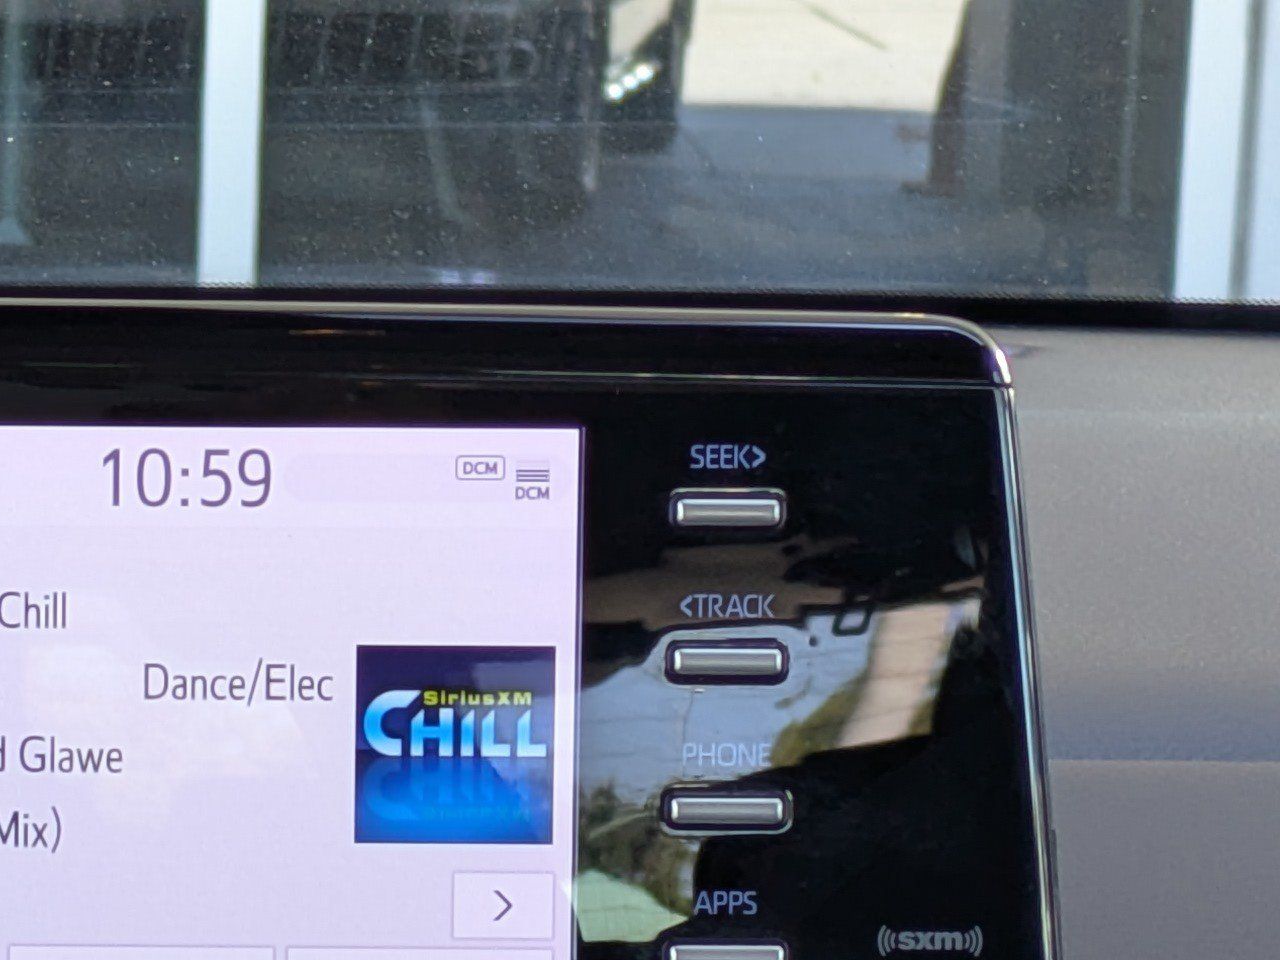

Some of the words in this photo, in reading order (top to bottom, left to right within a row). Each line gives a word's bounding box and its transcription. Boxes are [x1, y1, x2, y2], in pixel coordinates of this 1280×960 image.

[102, 447, 272, 508] 10:59
[462, 461, 498, 475] DCM
[514, 486, 550, 500] DCM
[143, 657, 334, 707] Dance/Elec
[423, 690, 532, 705] SiriusXM
[364, 690, 547, 757] CHILL
[19, 735, 123, 774] Glawe
[682, 743, 772, 768] PHONE
[694, 890, 758, 915] APPS
